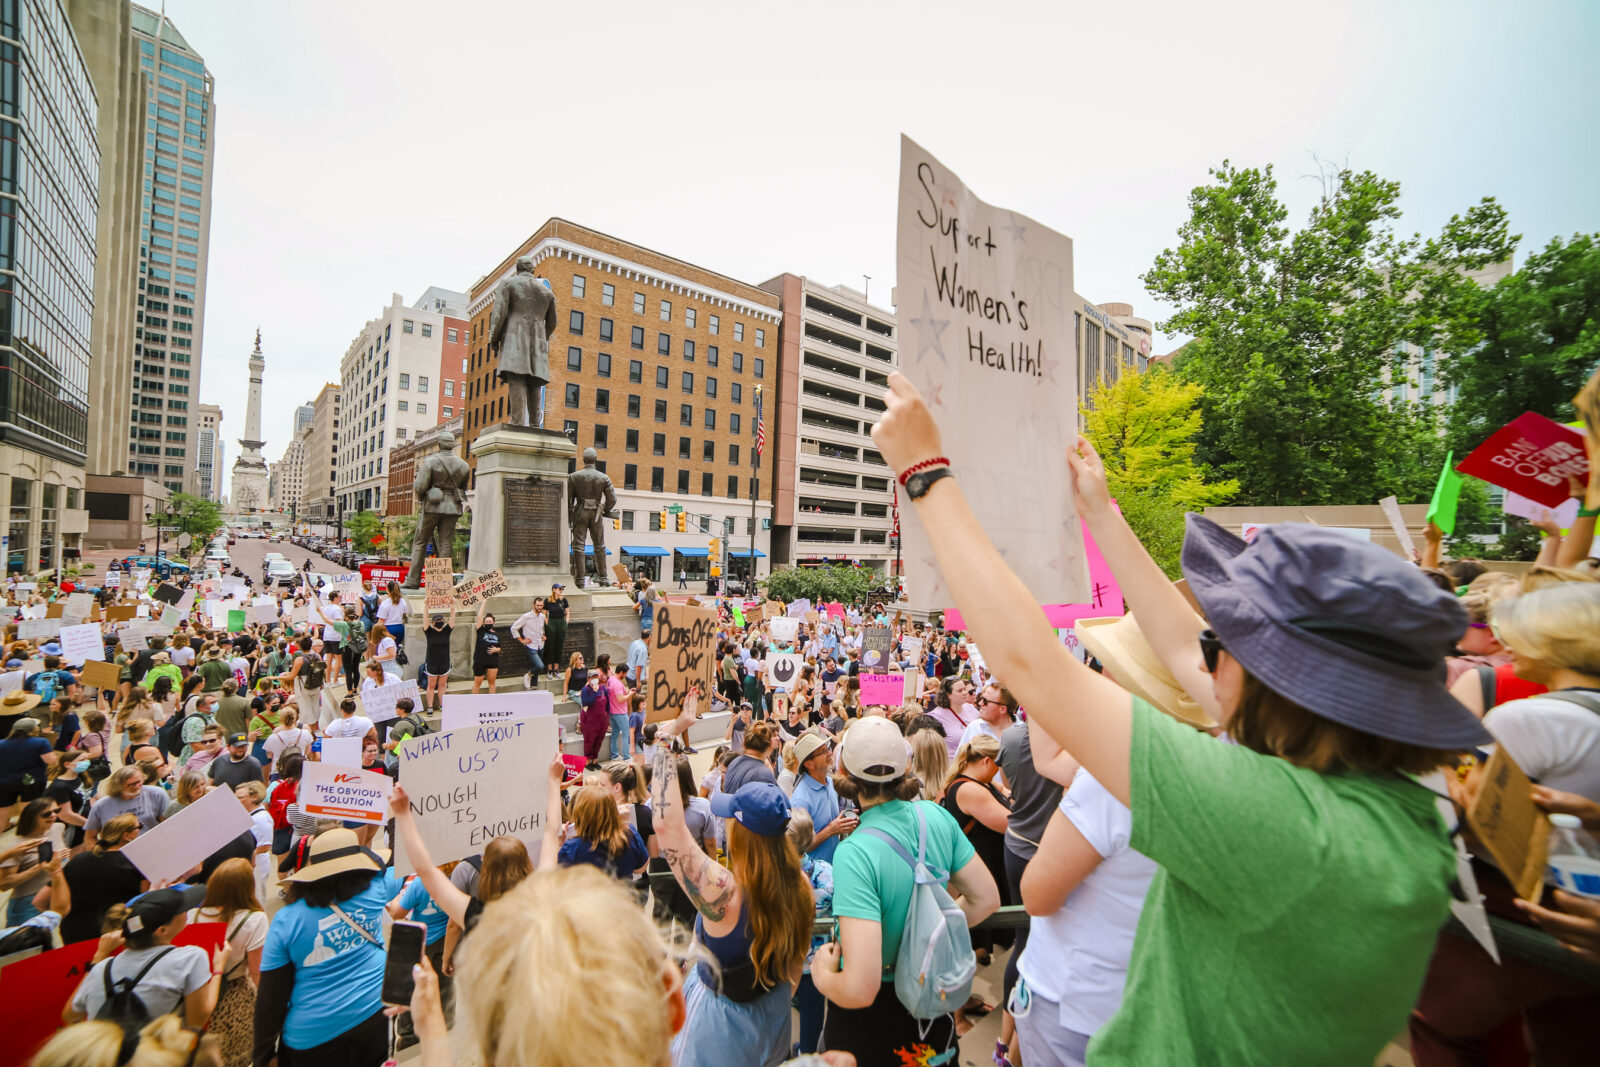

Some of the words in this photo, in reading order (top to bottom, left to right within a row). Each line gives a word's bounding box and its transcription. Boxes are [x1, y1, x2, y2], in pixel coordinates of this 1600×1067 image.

[930, 245, 1029, 331] Women's
[967, 326, 1042, 377] Health!
[425, 558, 448, 568] WHAT
[427, 580, 452, 590] FACTS
[456, 580, 475, 594] KEEP
[478, 570, 499, 583] BANS
[462, 595, 479, 606] OUR
[481, 582, 508, 599] BODIES
[472, 583, 486, 594] OFF
[657, 606, 691, 649] Bans
[691, 618, 716, 649] Off
[677, 647, 703, 673] Our
[404, 733, 454, 762] WHAT
[475, 722, 525, 744] ABOUT
[458, 748, 499, 774] US?
[316, 784, 335, 794] THE
[336, 786, 382, 799] OBVIOUS
[323, 794, 374, 808] SOLUTION
[409, 782, 478, 817] NOUGH
[452, 806, 477, 825] IS
